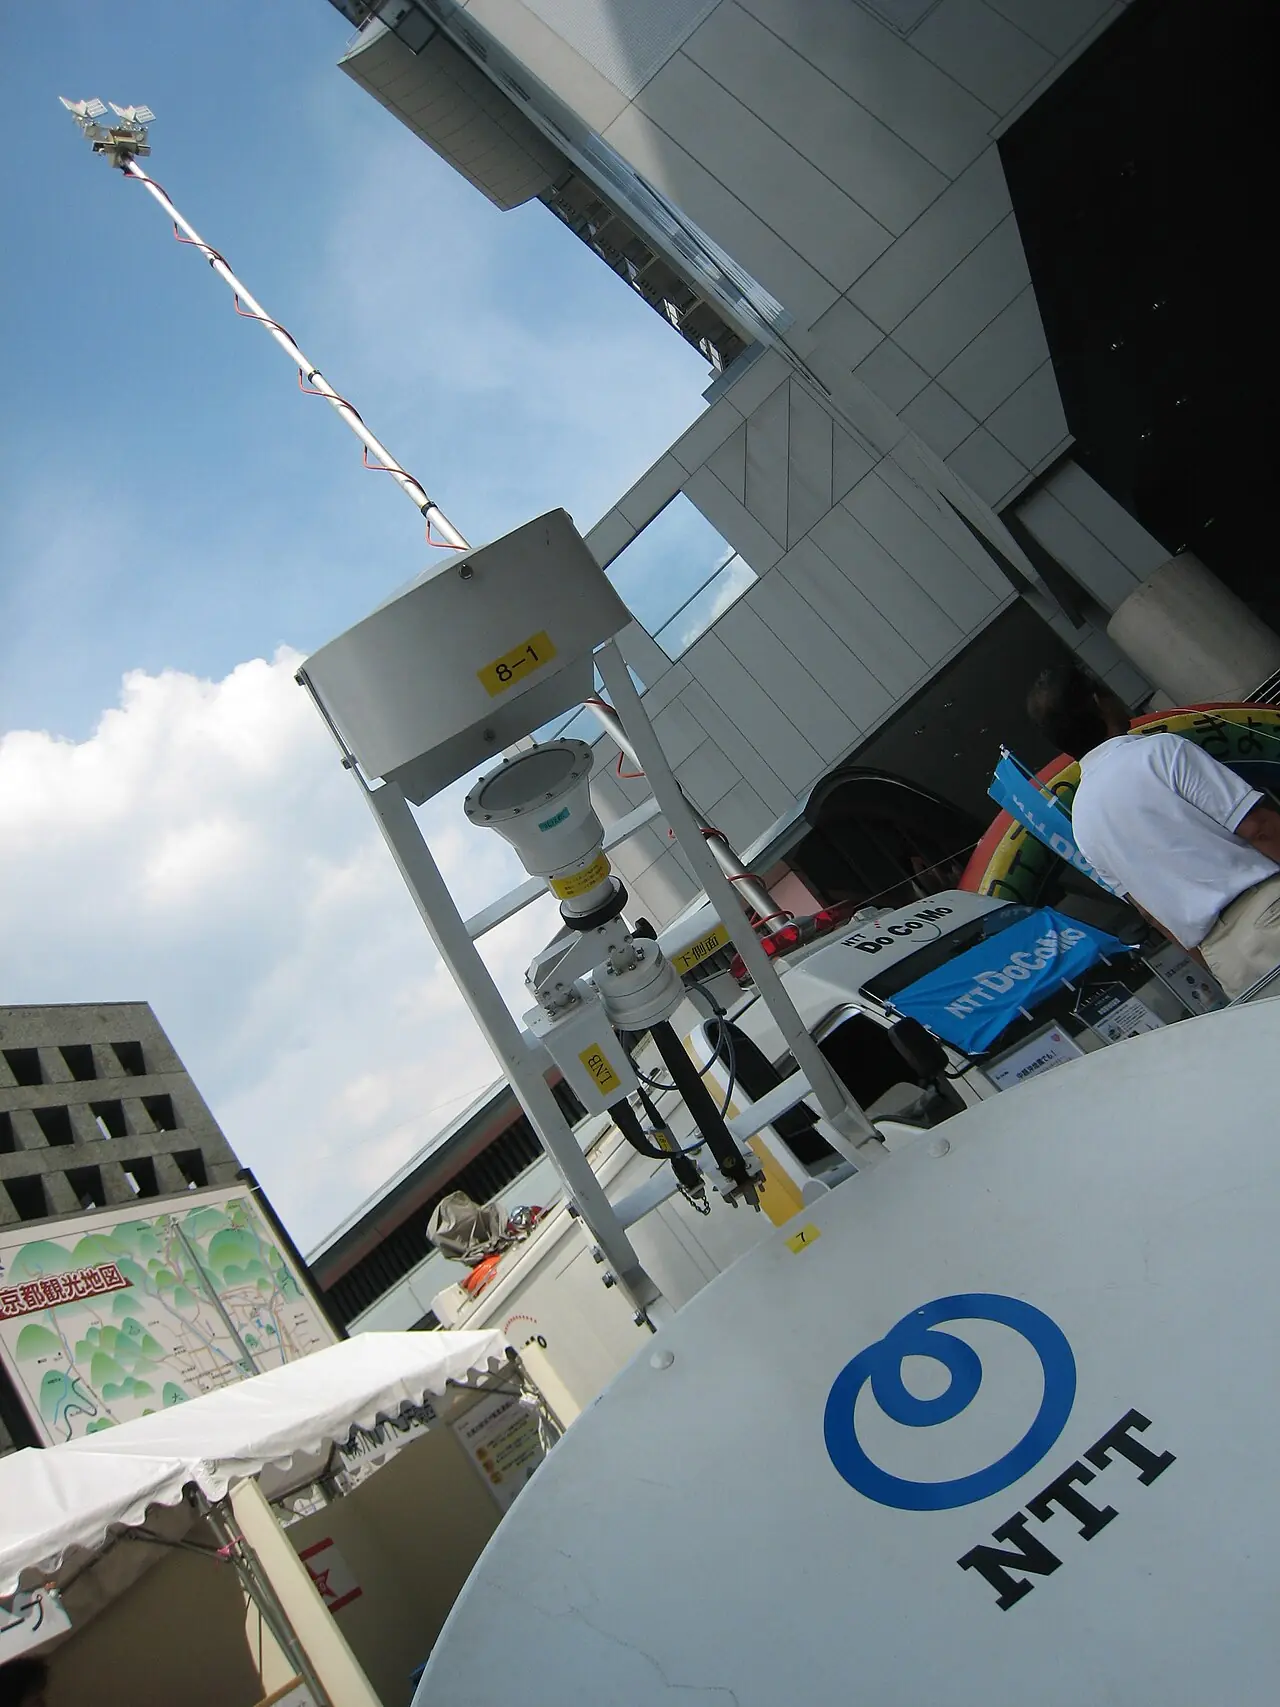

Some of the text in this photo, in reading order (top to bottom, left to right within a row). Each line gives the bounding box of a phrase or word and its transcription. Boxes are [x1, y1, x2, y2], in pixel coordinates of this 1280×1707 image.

[677, 937, 720, 968] 下側面
[840, 933, 868, 948] NTT
[587, 1053, 613, 1086] LNB
[796, 1231, 807, 1243] 7
[0, 1263, 126, 1315] 京都観光地図
[956, 1407, 1177, 1612] NTT
